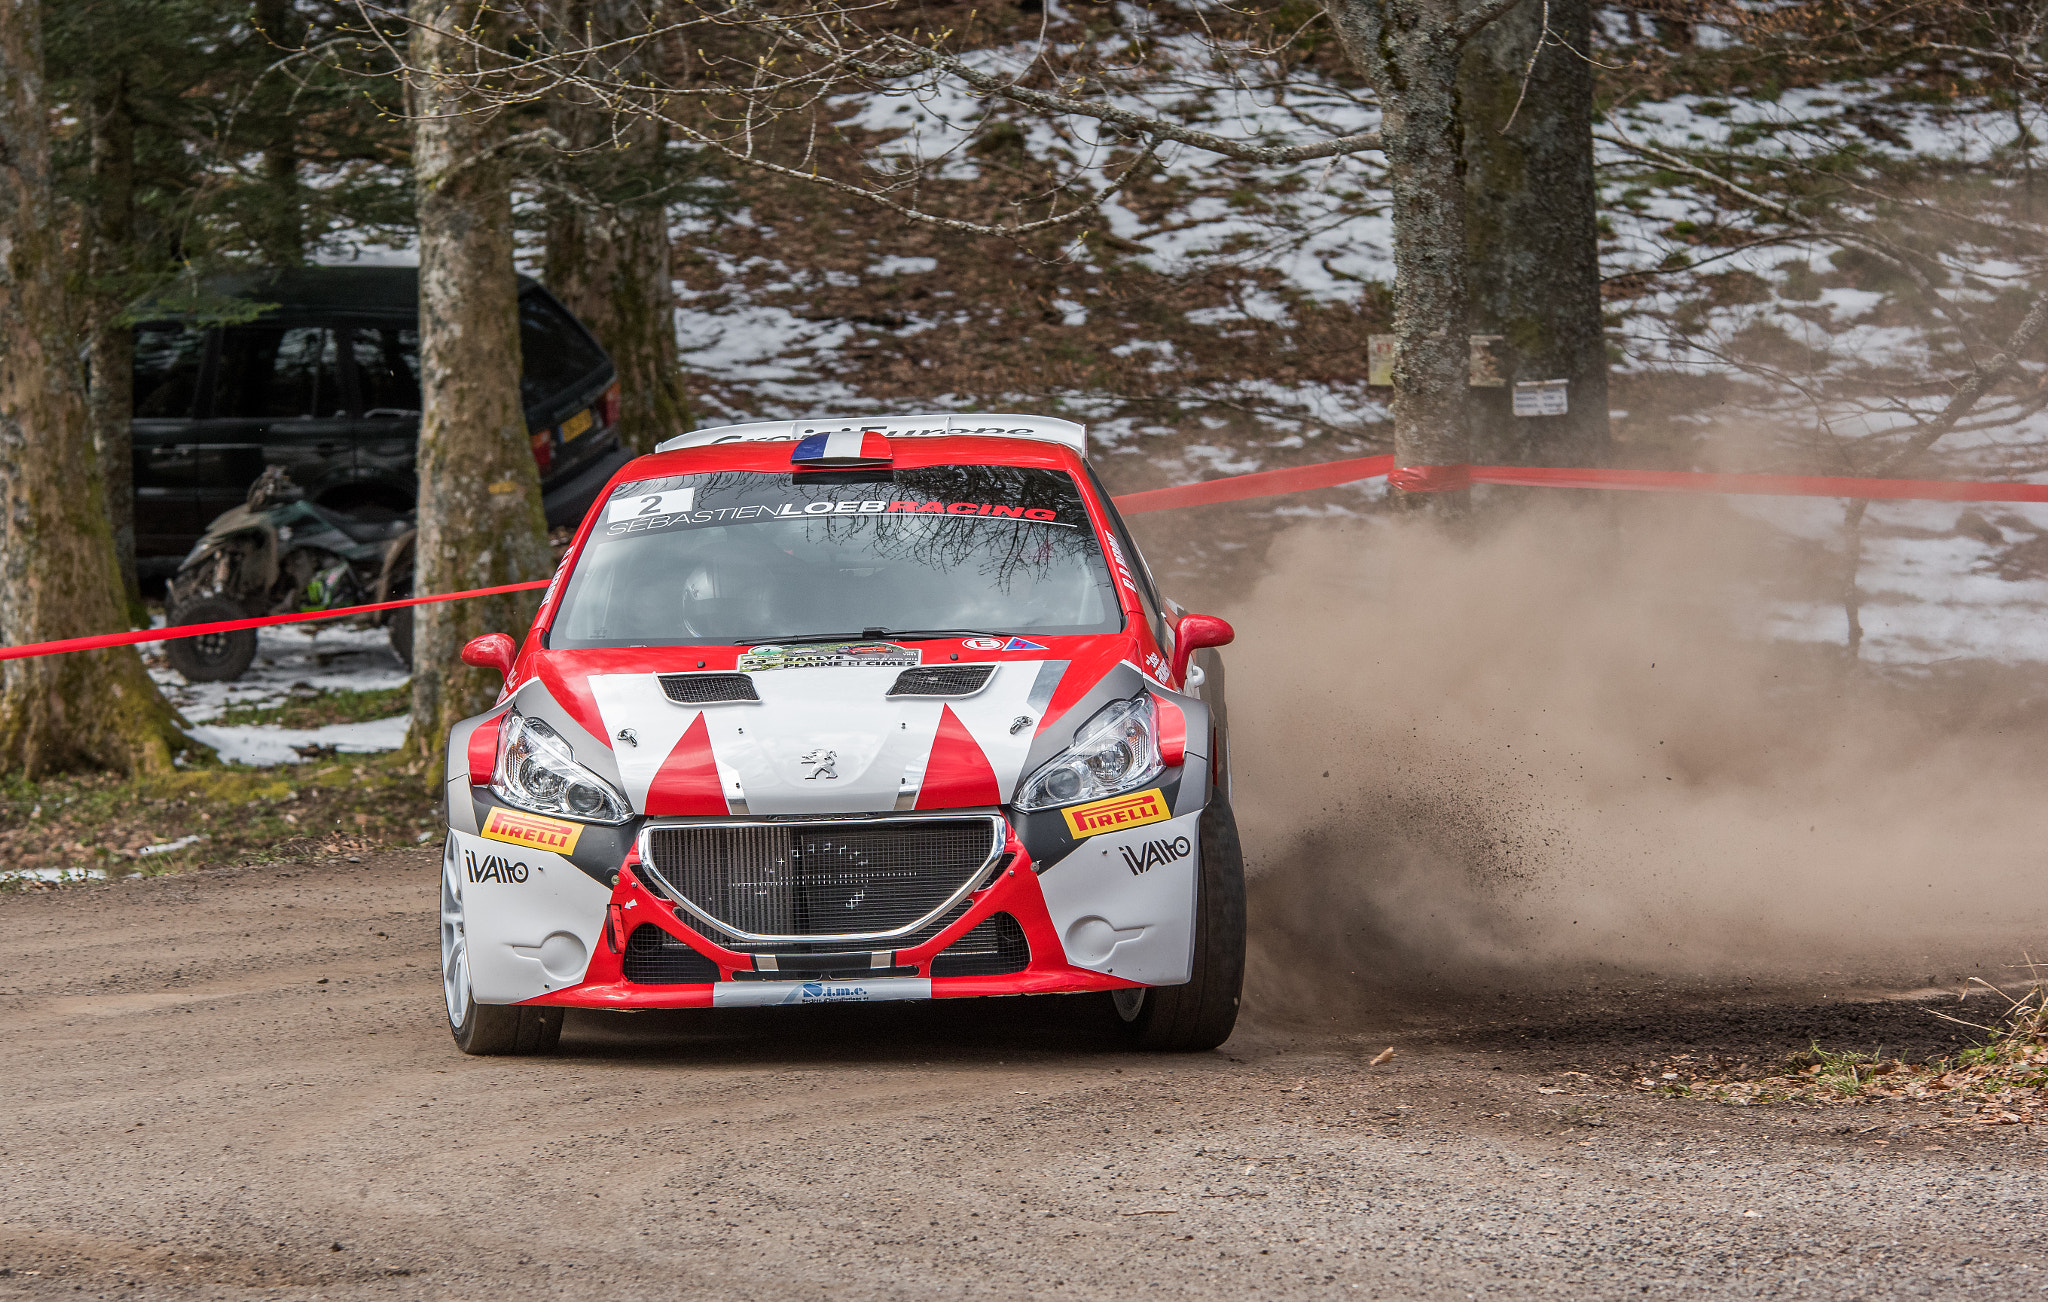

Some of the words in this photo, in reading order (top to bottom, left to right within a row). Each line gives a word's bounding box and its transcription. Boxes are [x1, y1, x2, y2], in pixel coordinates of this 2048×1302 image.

[638, 495, 663, 516] 2
[780, 500, 888, 516] LOEB
[886, 500, 1057, 522] RACING
[783, 655, 845, 663] RALLYE
[783, 661, 844, 669] PLAINE
[1072, 795, 1155, 832] PIRELLI
[490, 812, 573, 848] PIRELLI
